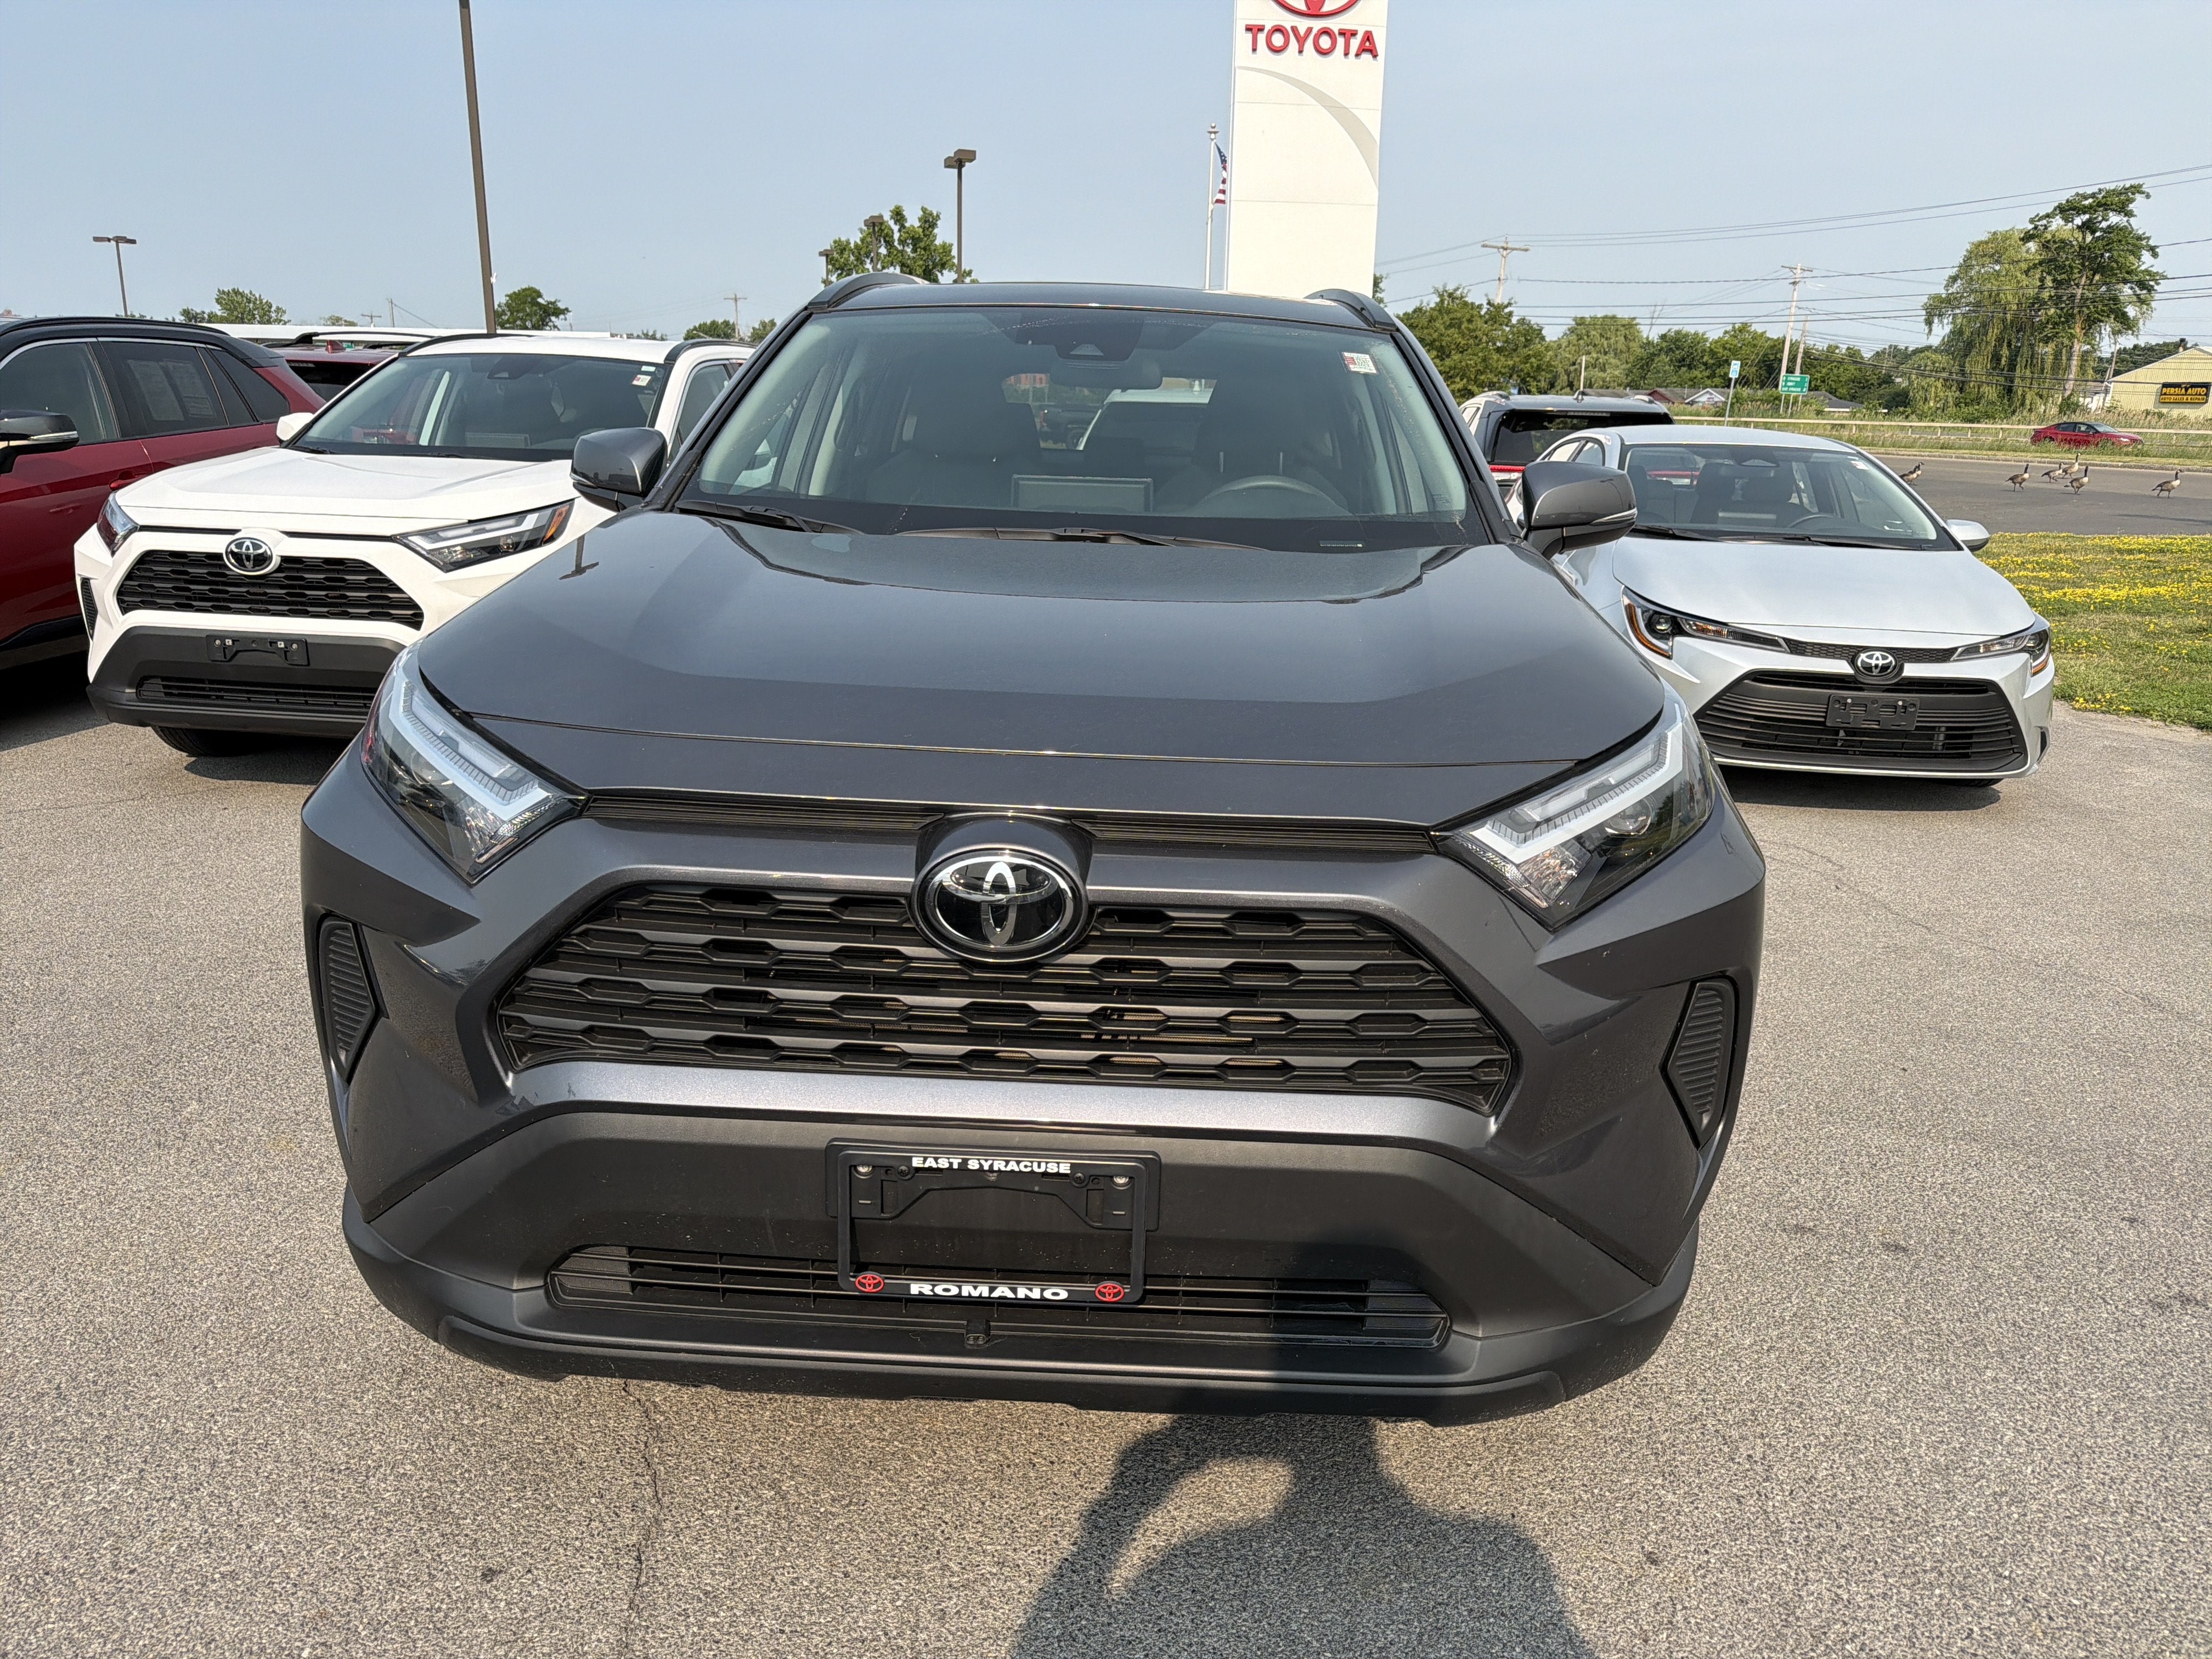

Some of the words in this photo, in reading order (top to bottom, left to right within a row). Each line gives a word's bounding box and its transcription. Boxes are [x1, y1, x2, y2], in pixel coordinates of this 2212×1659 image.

[1245, 24, 1379, 58] TOYOTA
[912, 1157, 962, 1169] EAST
[967, 1159, 1071, 1173] SYRACUSE
[910, 1283, 1069, 1300] ROMANO
